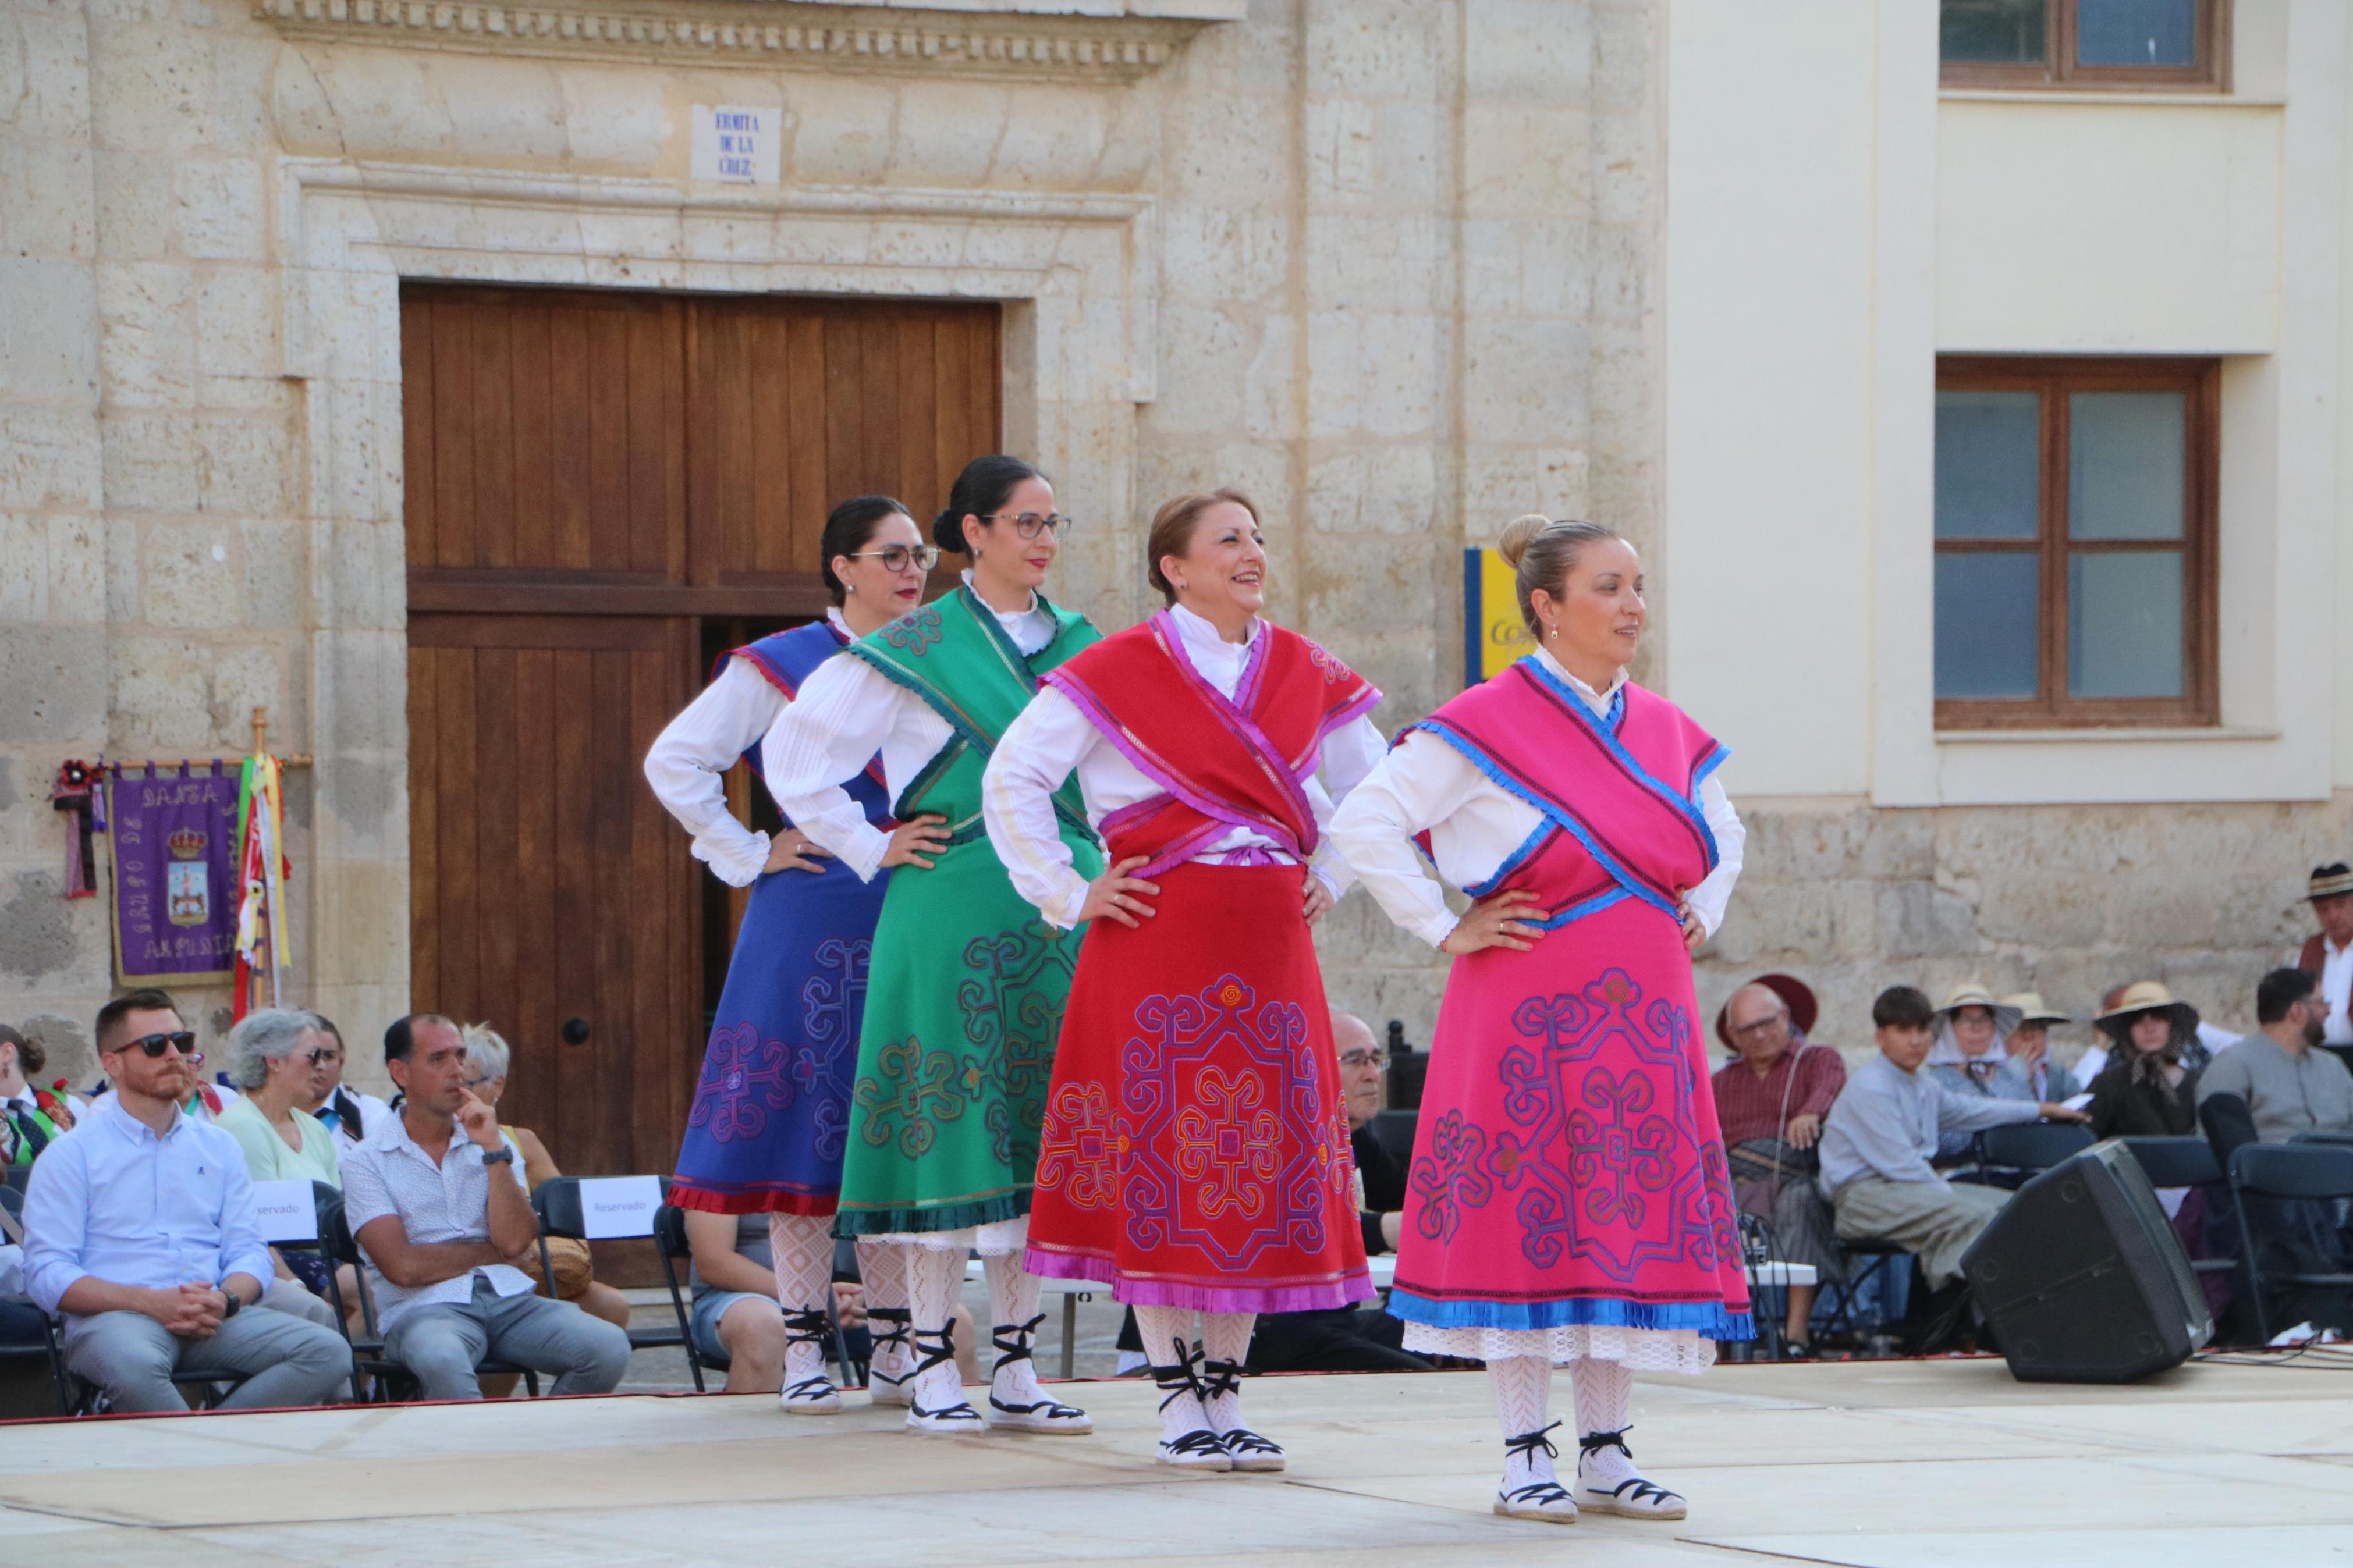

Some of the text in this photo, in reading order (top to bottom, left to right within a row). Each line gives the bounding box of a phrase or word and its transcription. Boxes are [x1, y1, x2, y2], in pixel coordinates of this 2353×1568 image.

[715, 112, 759, 132] ERMITA
[720, 134, 754, 154] DE LA
[718, 157, 751, 175] CRUZ
[1490, 618, 1529, 646] Co
[143, 784, 218, 808] DANZA
[121, 817, 152, 933] GRUPO DE
[257, 1204, 300, 1215] servado
[594, 1200, 646, 1213] Reservado
